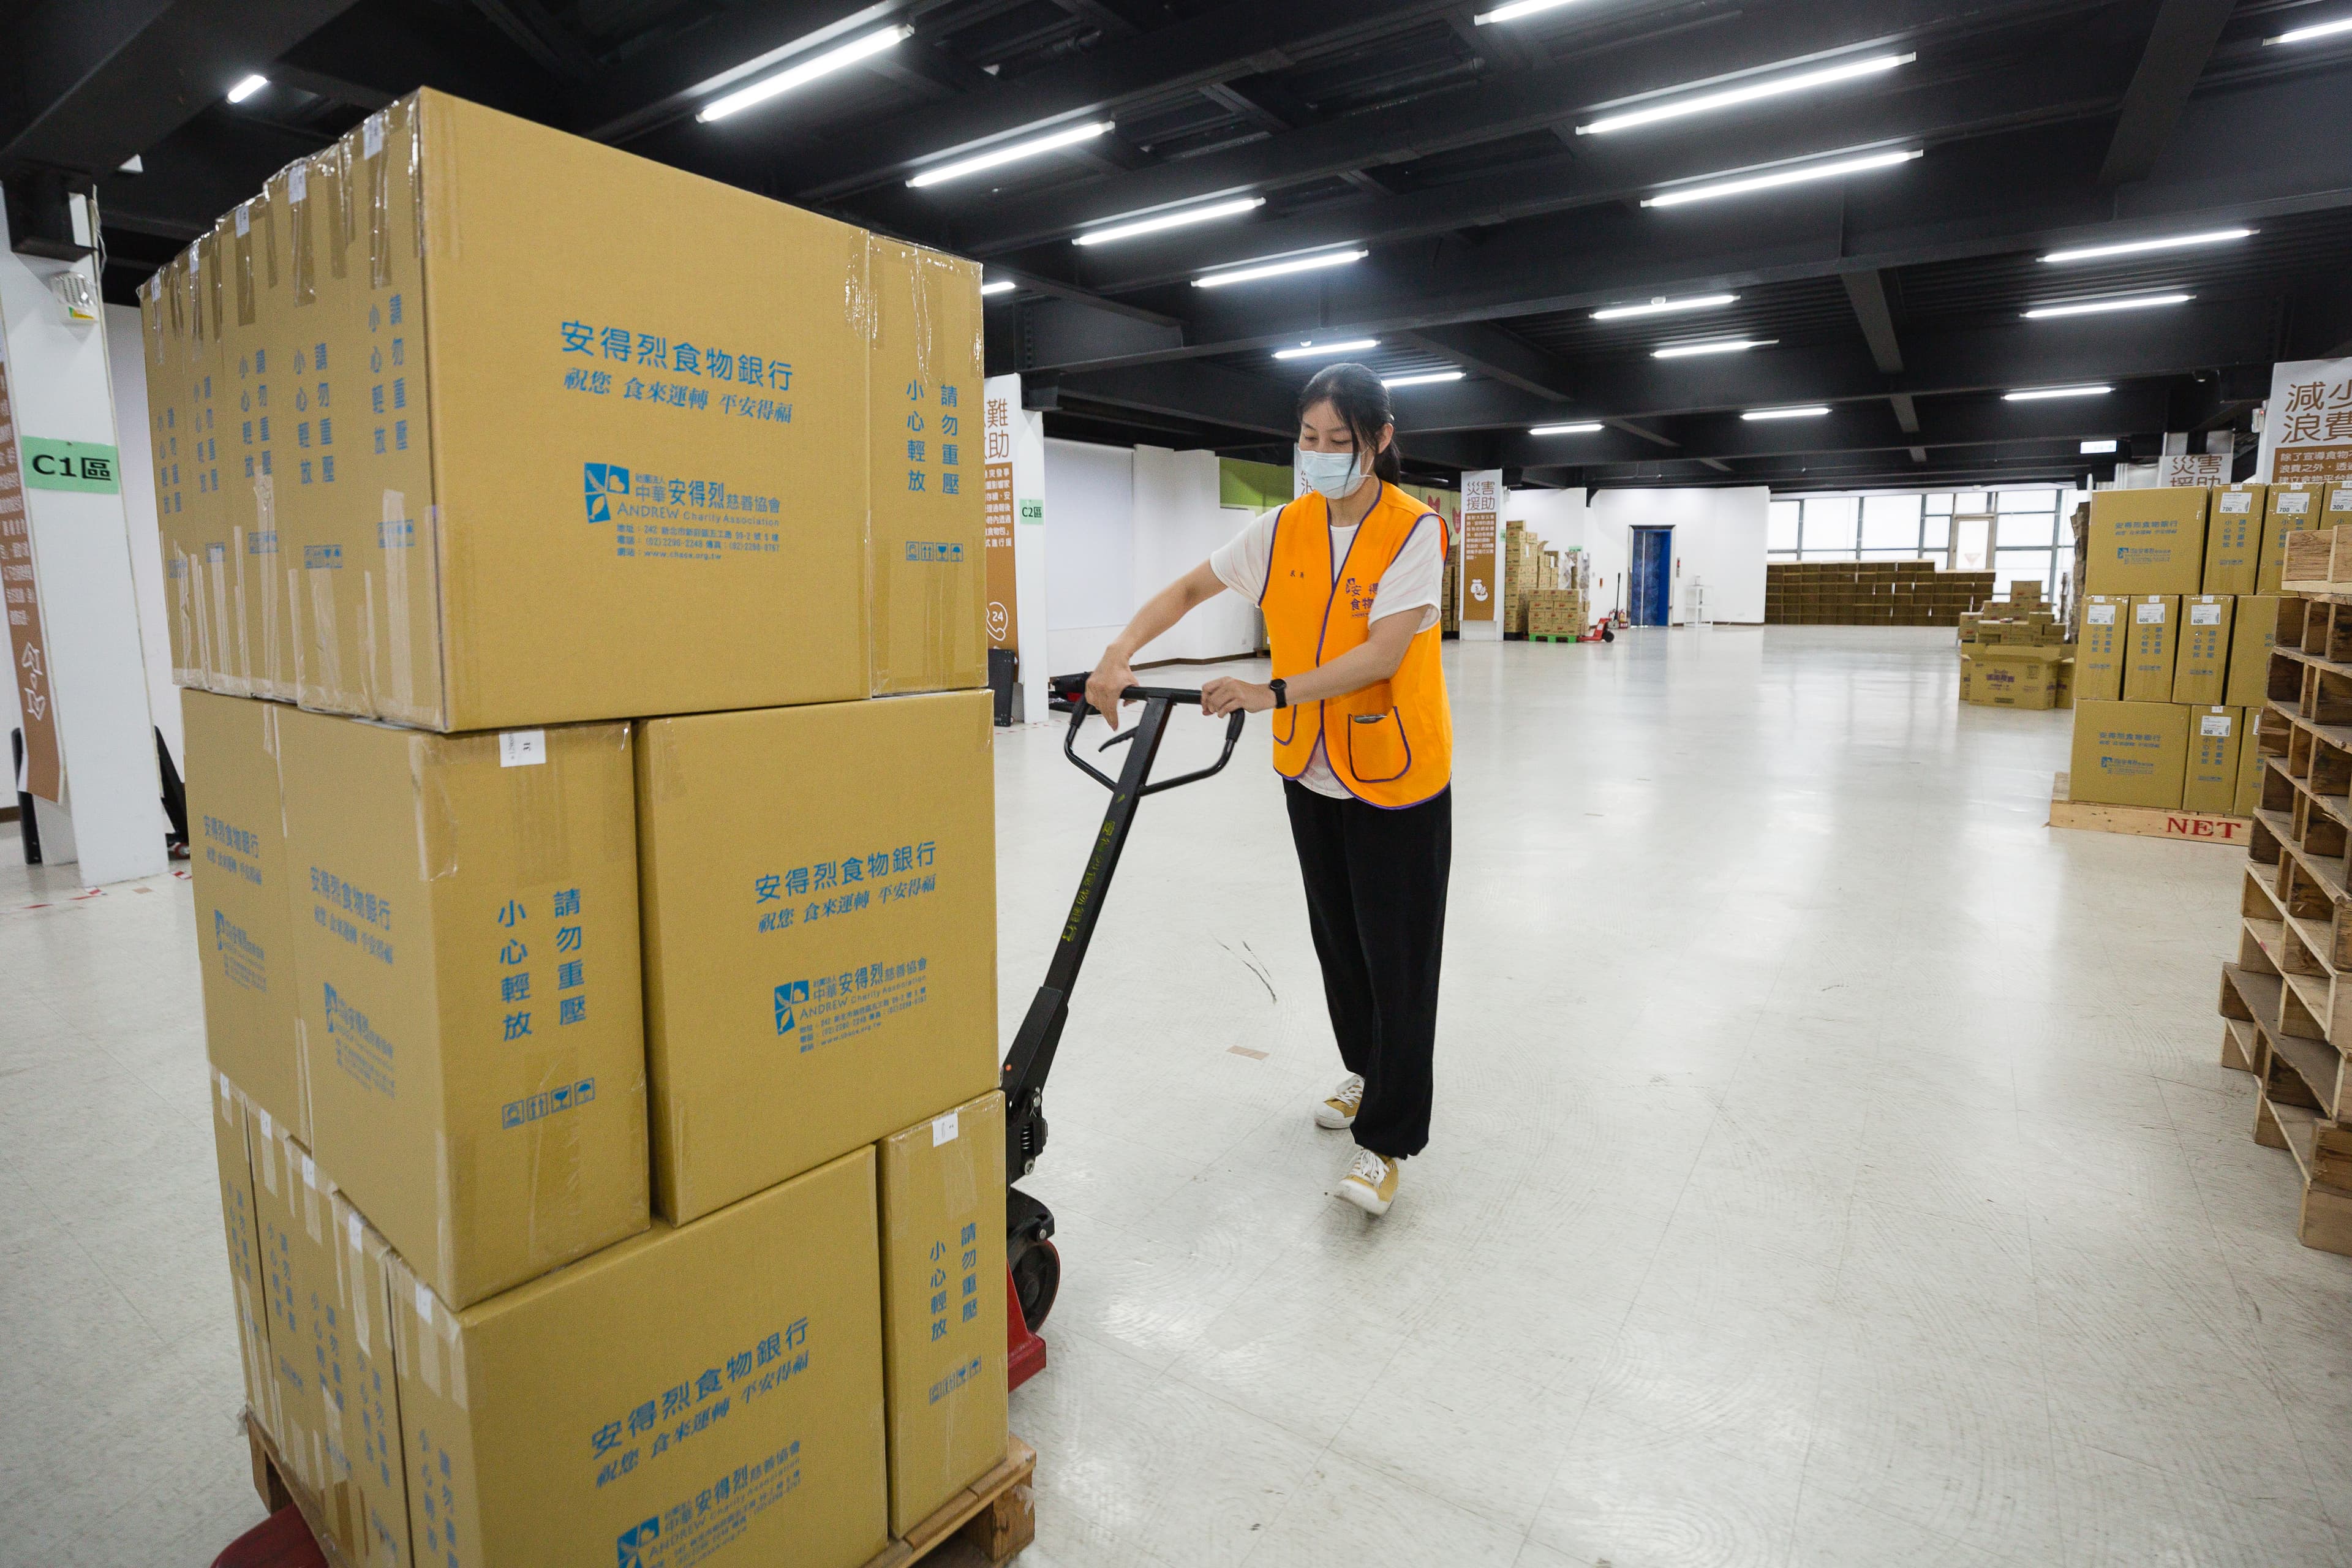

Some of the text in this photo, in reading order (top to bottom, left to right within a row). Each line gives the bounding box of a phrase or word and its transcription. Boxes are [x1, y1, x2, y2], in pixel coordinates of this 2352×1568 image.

[560, 320, 793, 392] 安得烈食物銀行
[563, 367, 793, 424] 祝您 食來運轉 平安得福
[984, 398, 1009, 428] 難
[906, 379, 925, 493] 小心輕放
[941, 384, 960, 496] 請勿重壓
[984, 430, 1009, 459] 助
[32, 454, 111, 481] C1區
[2171, 455, 2223, 475] 災害
[1466, 496, 1495, 511] 援助
[1467, 480, 1495, 496] 災害
[617, 502, 780, 527] ANDREW Charity Association
[1022, 507, 1042, 518] C2區
[992, 611, 1003, 622] 24
[2166, 816, 2242, 839] NET
[755, 841, 936, 905] 安得烈食物銀行
[758, 908, 794, 933] 祝您
[803, 890, 870, 923] 食來運轉
[497, 899, 532, 1041] 小心輕放
[554, 889, 586, 1026] 請勿重壓
[800, 997, 848, 1021] ANDREW
[961, 1223, 978, 1323] 請勿重壓
[930, 1240, 948, 1343] 小心輕放
[592, 1316, 809, 1460] 安得烈食物銀行
